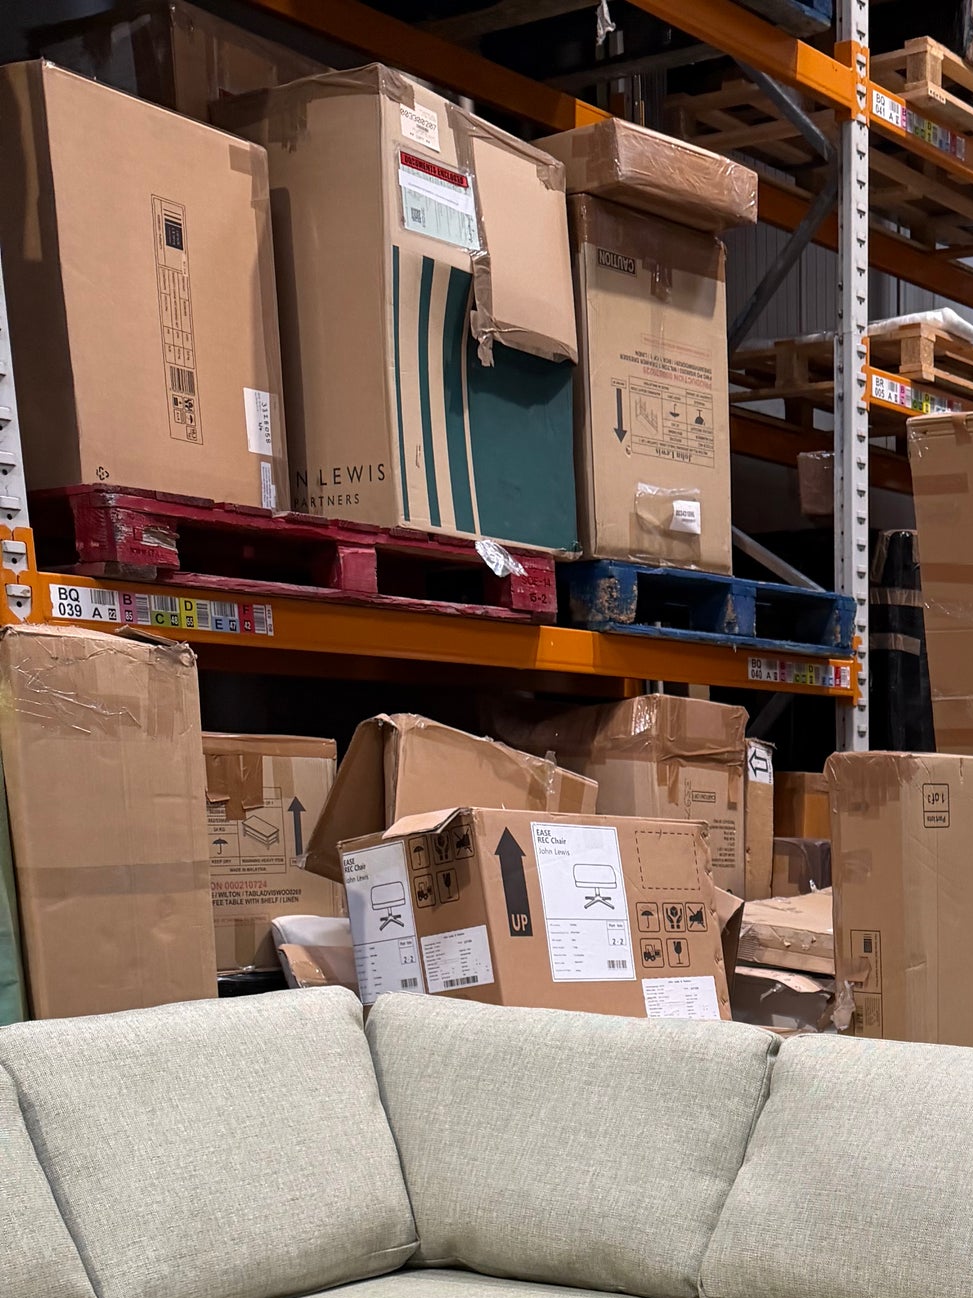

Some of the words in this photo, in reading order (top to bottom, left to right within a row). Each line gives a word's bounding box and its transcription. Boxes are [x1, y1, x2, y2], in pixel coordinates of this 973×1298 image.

[600, 250, 635, 272] CAUTION
[674, 374, 712, 390] PRODUCTION
[656, 448, 674, 459] Lewis
[676, 452, 692, 462] John
[319, 464, 385, 486] LEWIS
[294, 494, 360, 508] PARTNERS
[58, 588, 80, 602] BQ
[123, 594, 132, 605] B
[58, 603, 82, 618] 039
[92, 608, 102, 619] A
[184, 600, 193, 611] D
[243, 605, 250, 615] F
[155, 614, 164, 624] C
[215, 619, 223, 630] E
[536, 828, 551, 837] EASE
[344, 858, 354, 866] EASE
[283, 896, 299, 904] LINEN
[512, 914, 528, 932] UP
